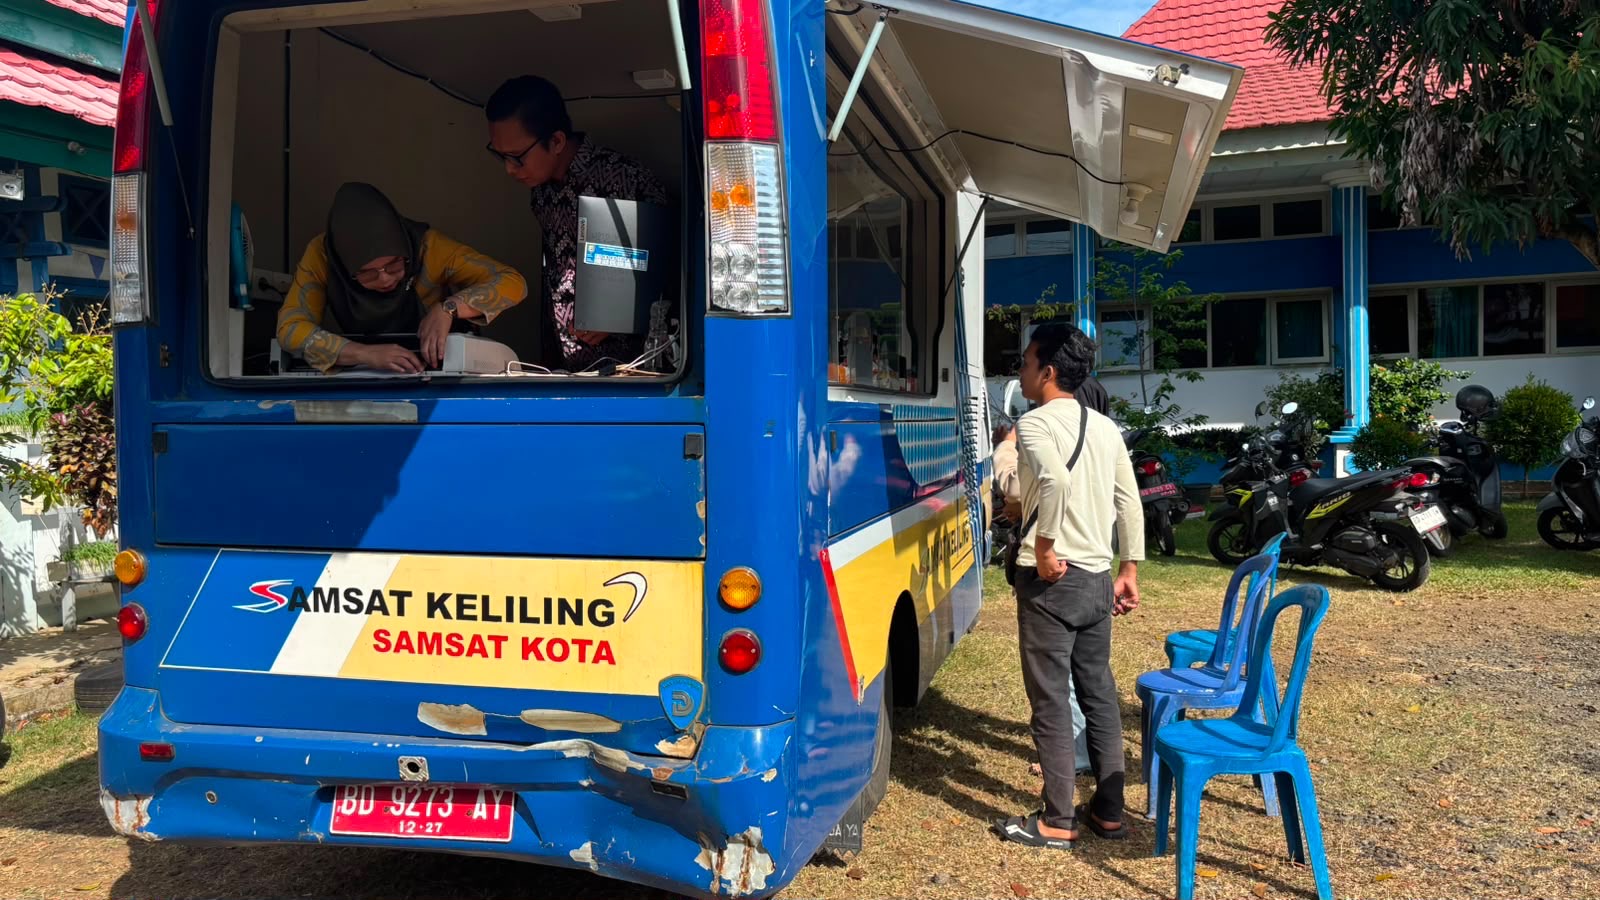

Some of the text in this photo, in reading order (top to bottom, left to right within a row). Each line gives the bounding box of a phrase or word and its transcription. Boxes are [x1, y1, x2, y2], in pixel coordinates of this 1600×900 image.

[232, 579, 616, 627] SAMSAT KELILING
[372, 628, 617, 666] SAMSAT KOTA
[341, 784, 375, 815] BD
[389, 785, 454, 818] 9273
[472, 788, 505, 820] AY
